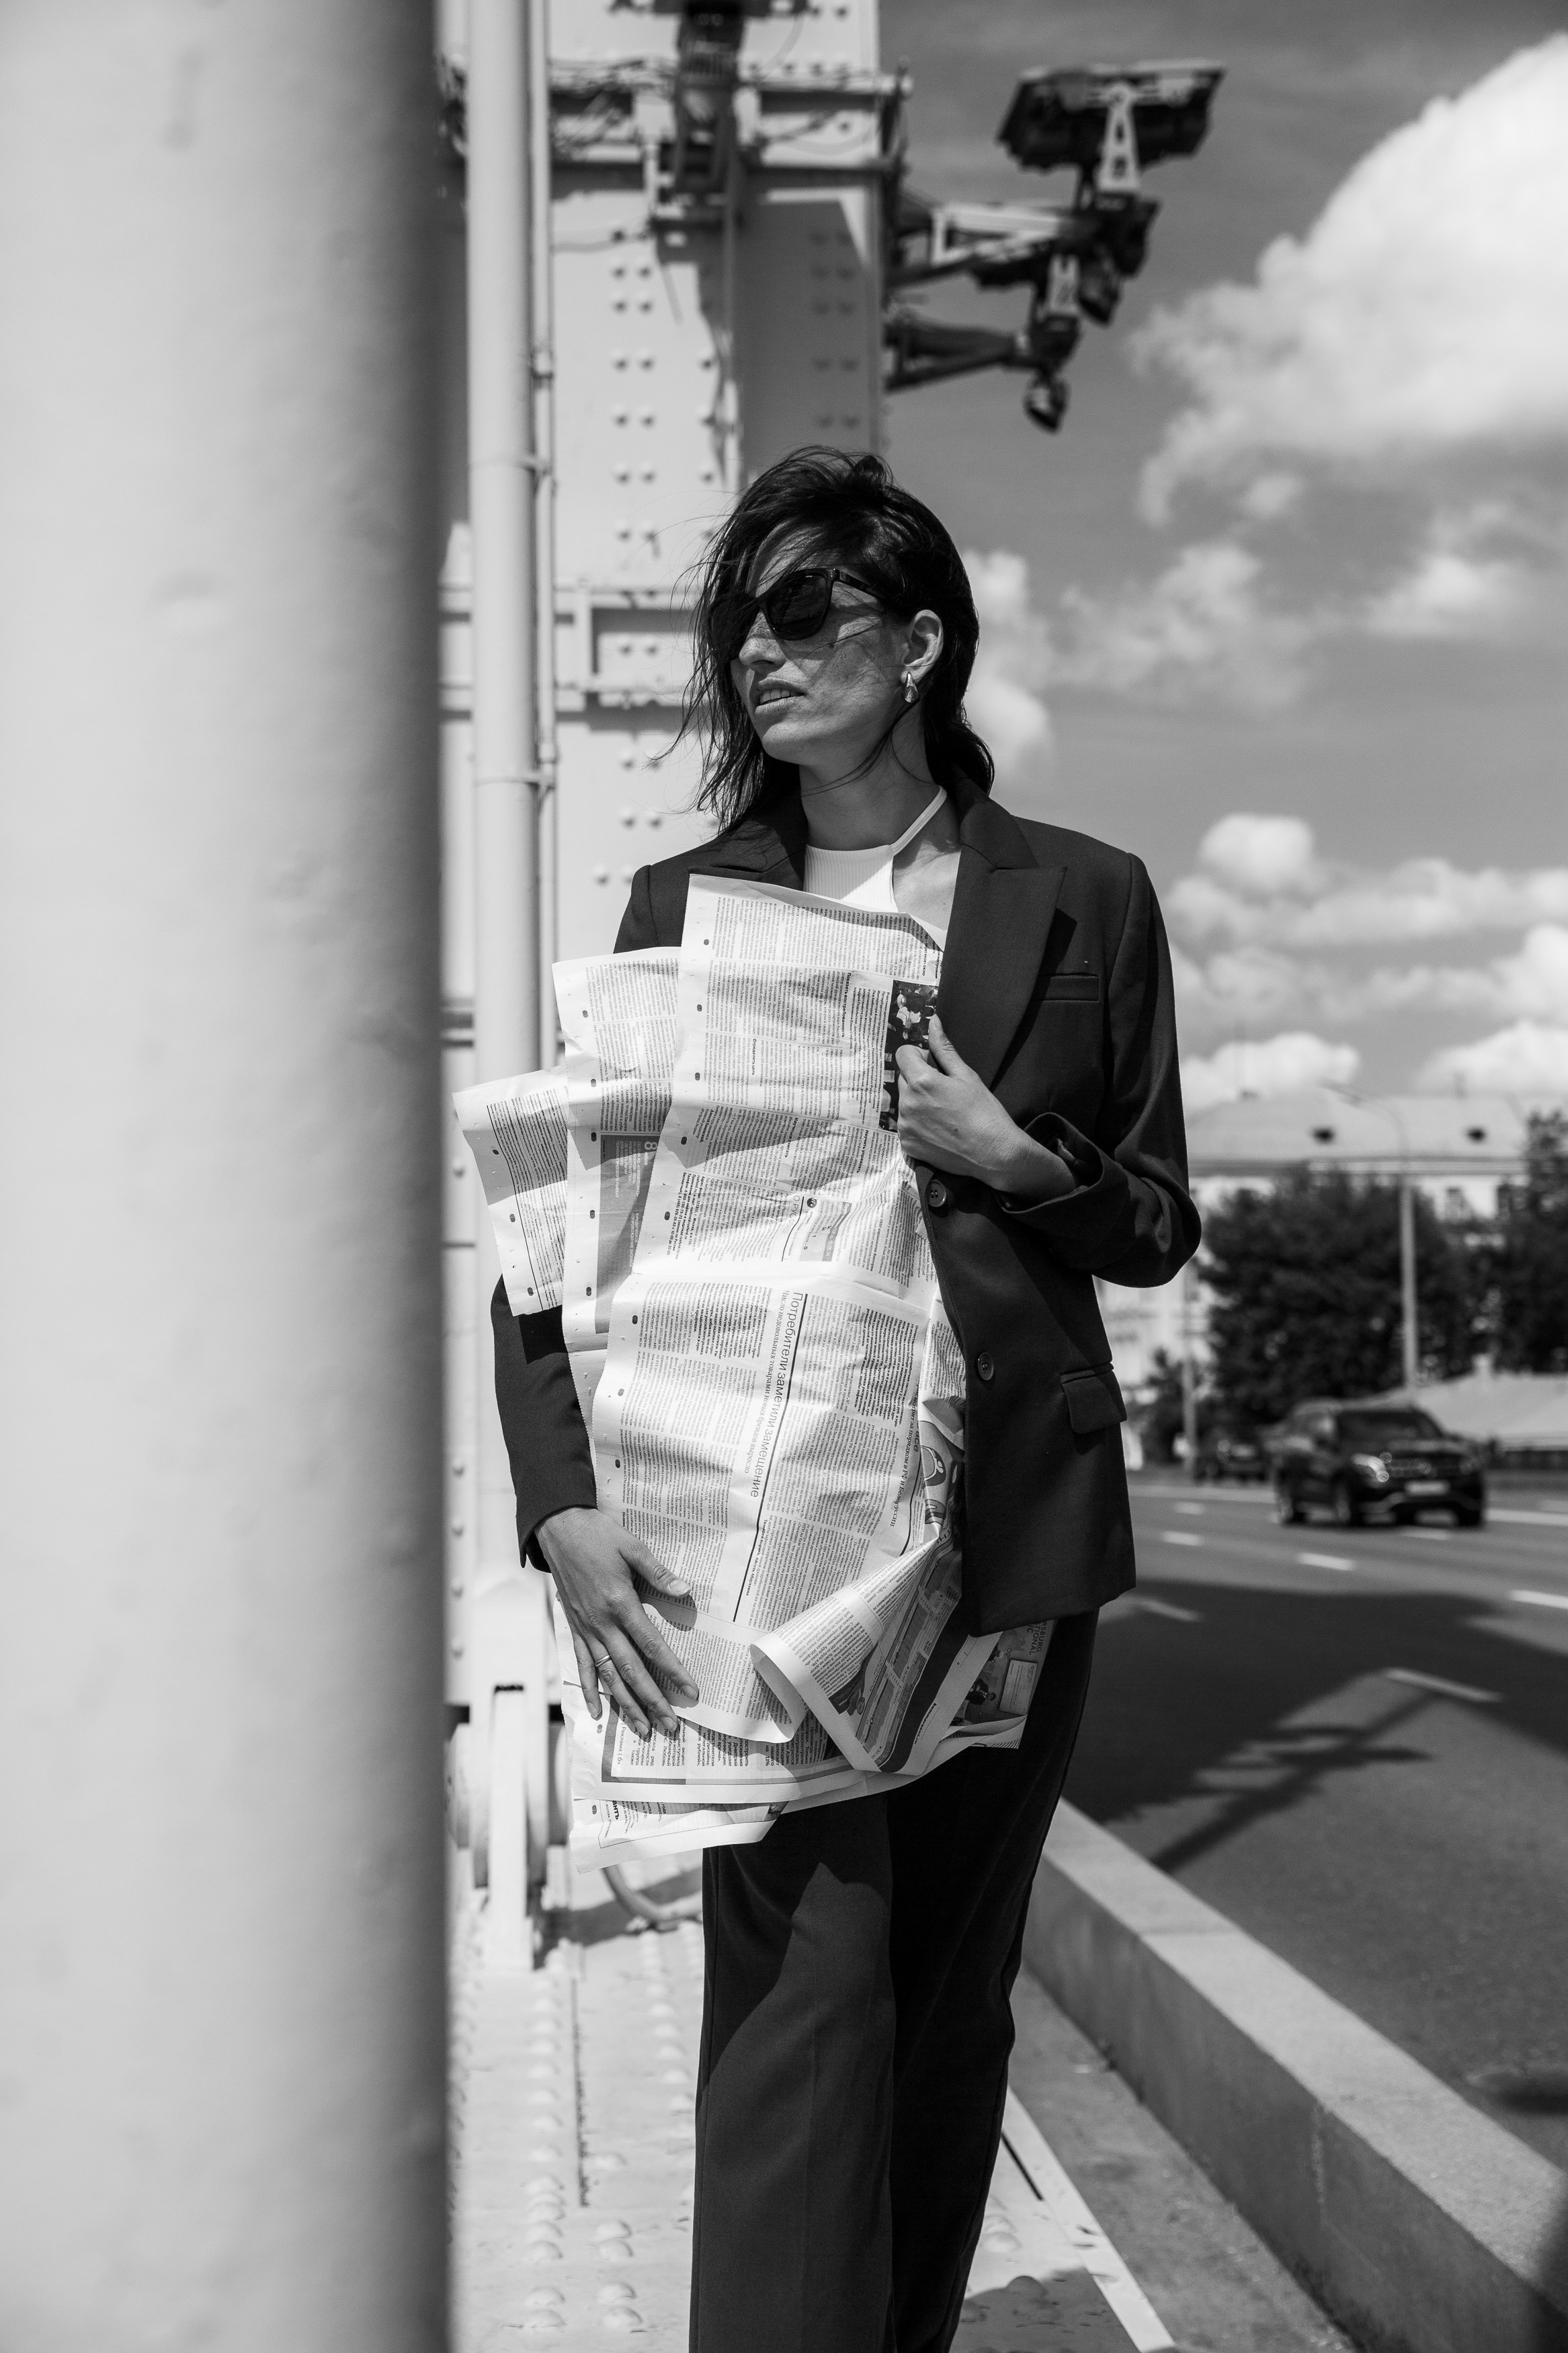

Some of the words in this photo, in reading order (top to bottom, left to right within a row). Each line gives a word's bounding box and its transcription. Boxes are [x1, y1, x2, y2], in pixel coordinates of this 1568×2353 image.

[840, 995, 848, 1037] востребованность
[788, 1117, 798, 1139] Научиться
[643, 1141, 657, 1150] 8
[856, 1150, 865, 1172] управлять
[684, 1206, 694, 1239] rusfond@rusfond.ru
[778, 1289, 789, 1311] Число
[769, 1312, 785, 1359] недовольных
[776, 1291, 804, 1372] Потребители
[763, 1360, 775, 1394] товарами
[758, 1394, 769, 1416] новых
[765, 1372, 786, 1428] заметили
[750, 1416, 764, 1443] брендов
[909, 1421, 915, 1429] за
[743, 1443, 757, 1474] выросло
[903, 1429, 914, 1464] порядком
[749, 1429, 774, 1498] замещение
[900, 1469, 908, 1480] РФ
[889, 1486, 904, 1527] Белоруссии
[618, 1726, 626, 1751] Реклама
[912, 1702, 938, 1745] kommersant.ru
